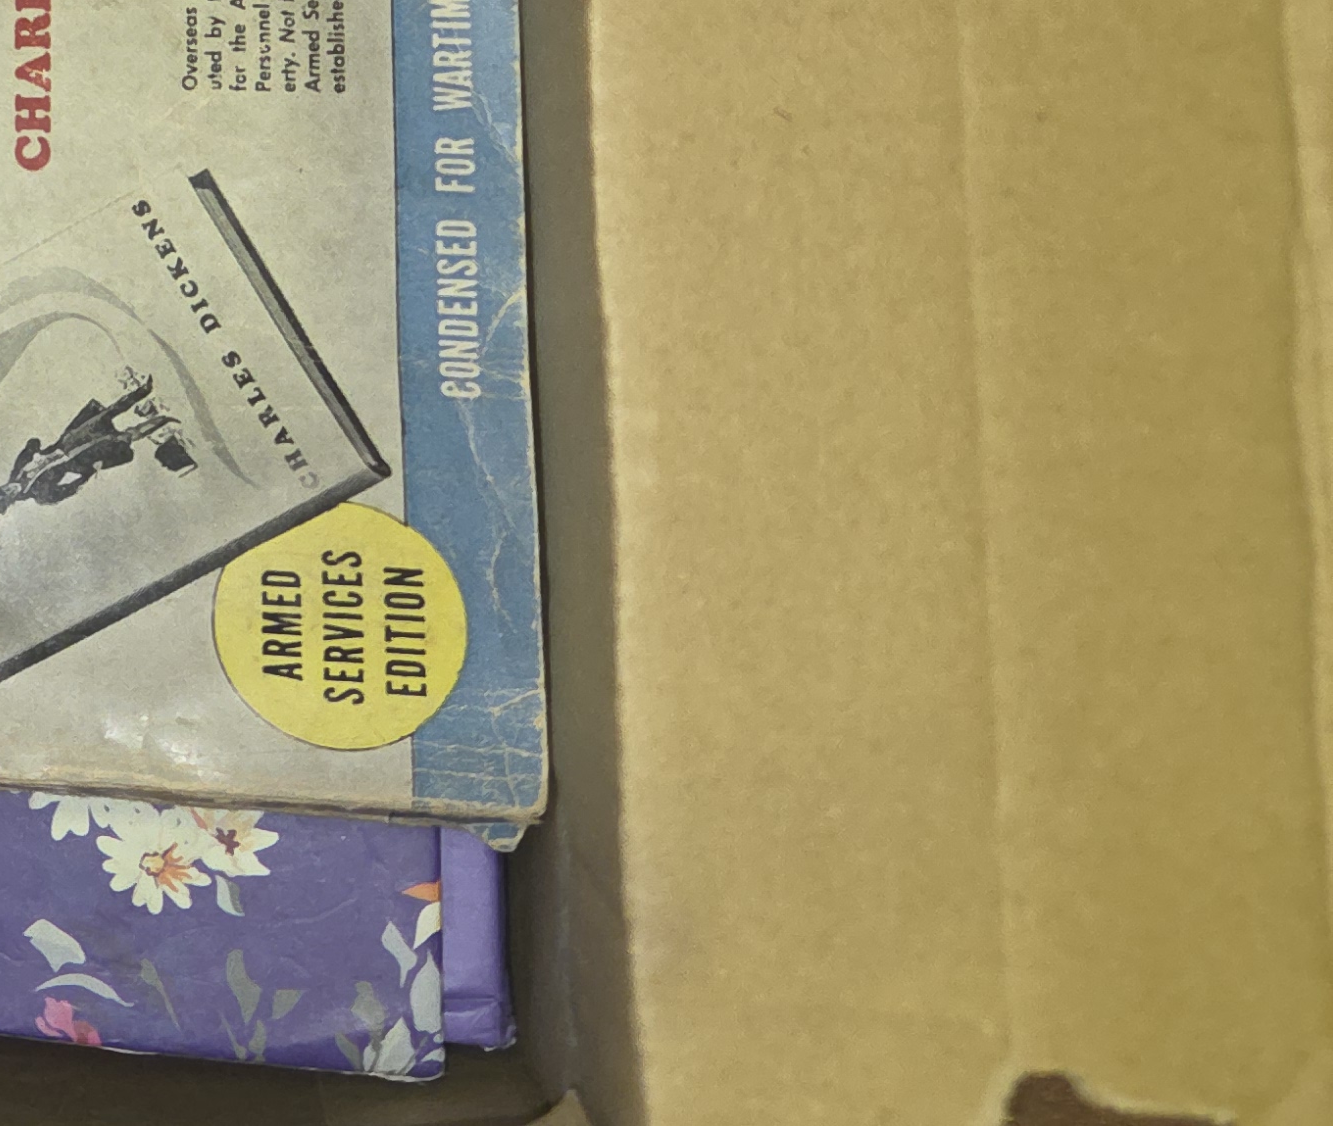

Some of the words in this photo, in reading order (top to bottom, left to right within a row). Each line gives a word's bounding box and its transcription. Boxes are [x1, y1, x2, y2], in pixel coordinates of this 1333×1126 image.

[182, 7, 198, 90] Overseas
[204, 17, 225, 38] by
[229, 24, 245, 52] the
[279, 10, 295, 43] Not
[204, 51, 222, 90] uted
[229, 66, 246, 91] for
[281, 52, 300, 93] erty.
[301, 31, 321, 93] Armed
[435, 135, 476, 193] FOR
[132, 200, 221, 334] DICKENS
[436, 219, 481, 399] CONDENSED
[221, 351, 319, 489] CHARLES
[261, 570, 304, 681] ARMED
[321, 550, 366, 705] SERVICES
[382, 567, 428, 698] EDITION
